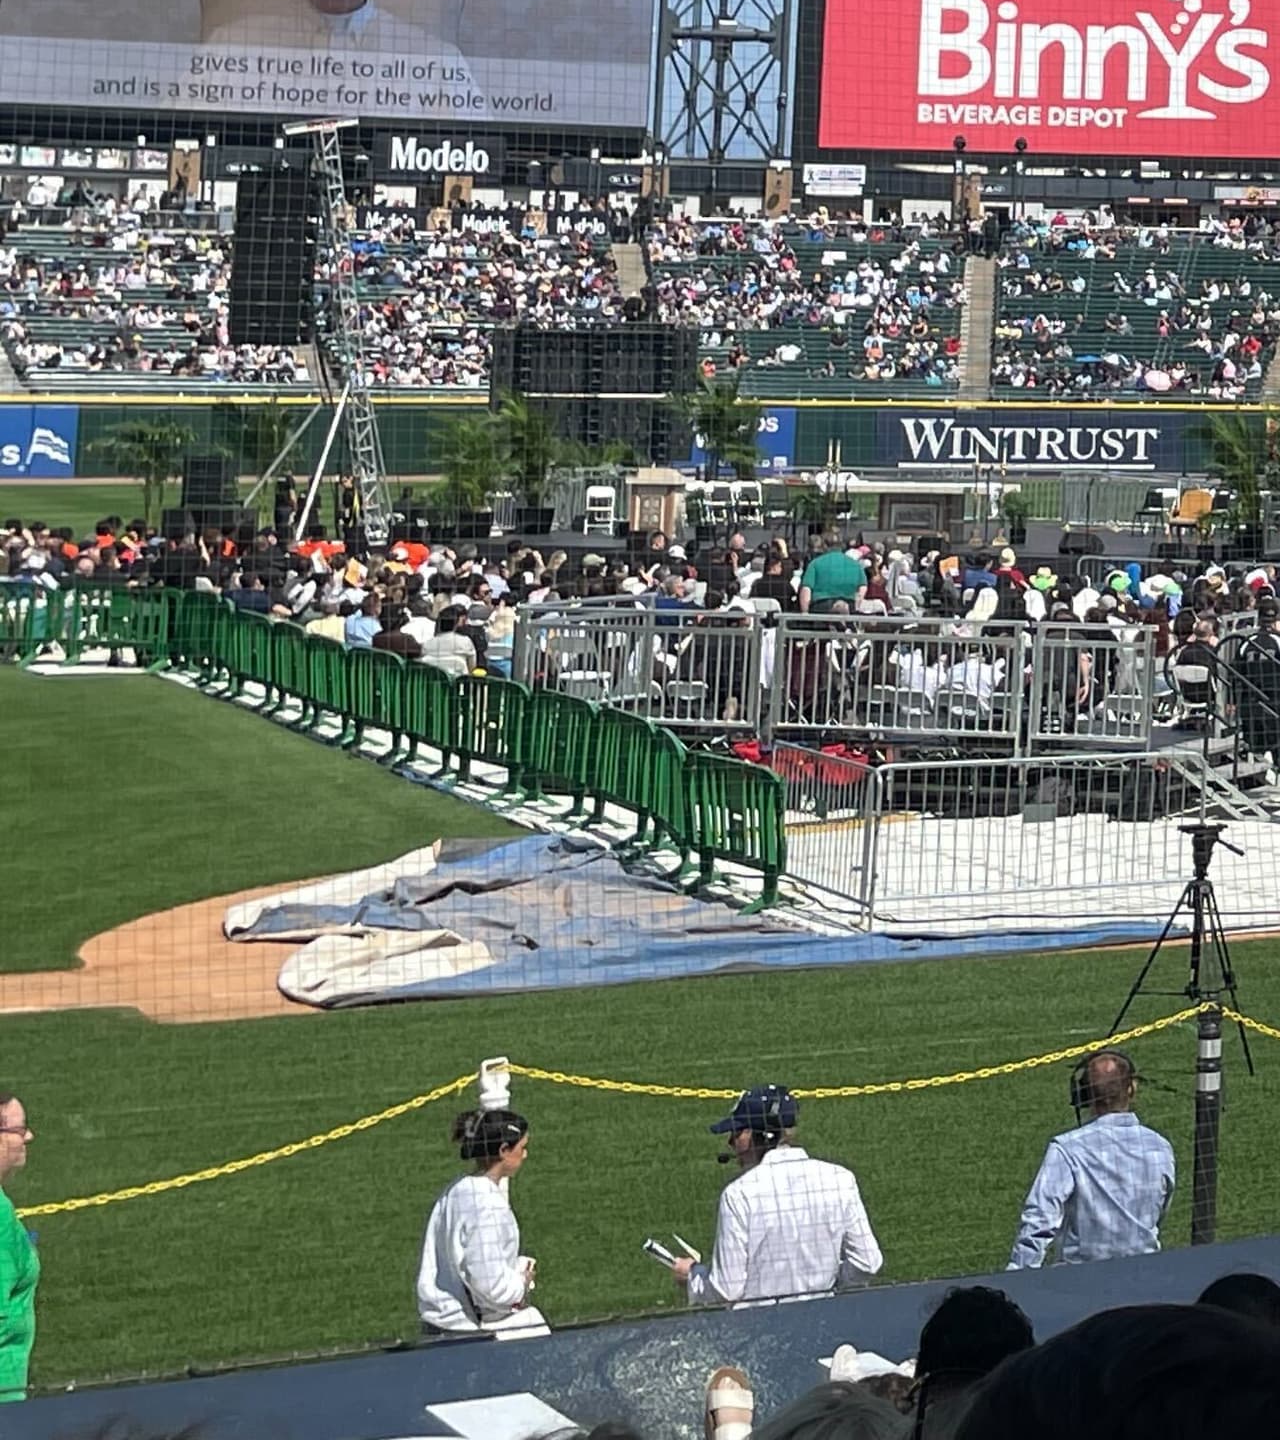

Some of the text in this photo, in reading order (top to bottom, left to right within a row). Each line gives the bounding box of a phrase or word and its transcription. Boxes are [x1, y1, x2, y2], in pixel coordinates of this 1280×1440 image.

[190, 53, 249, 75] gives
[257, 55, 303, 74] true
[310, 56, 344, 75] life
[352, 61, 374, 77] to
[381, 58, 405, 79] all
[412, 59, 436, 81] of
[93, 76, 557, 112] and is a sign of hope for the whole world.
[917, 103, 1128, 129] BEVERAGE DEPOT
[391, 136, 490, 173] Modelo
